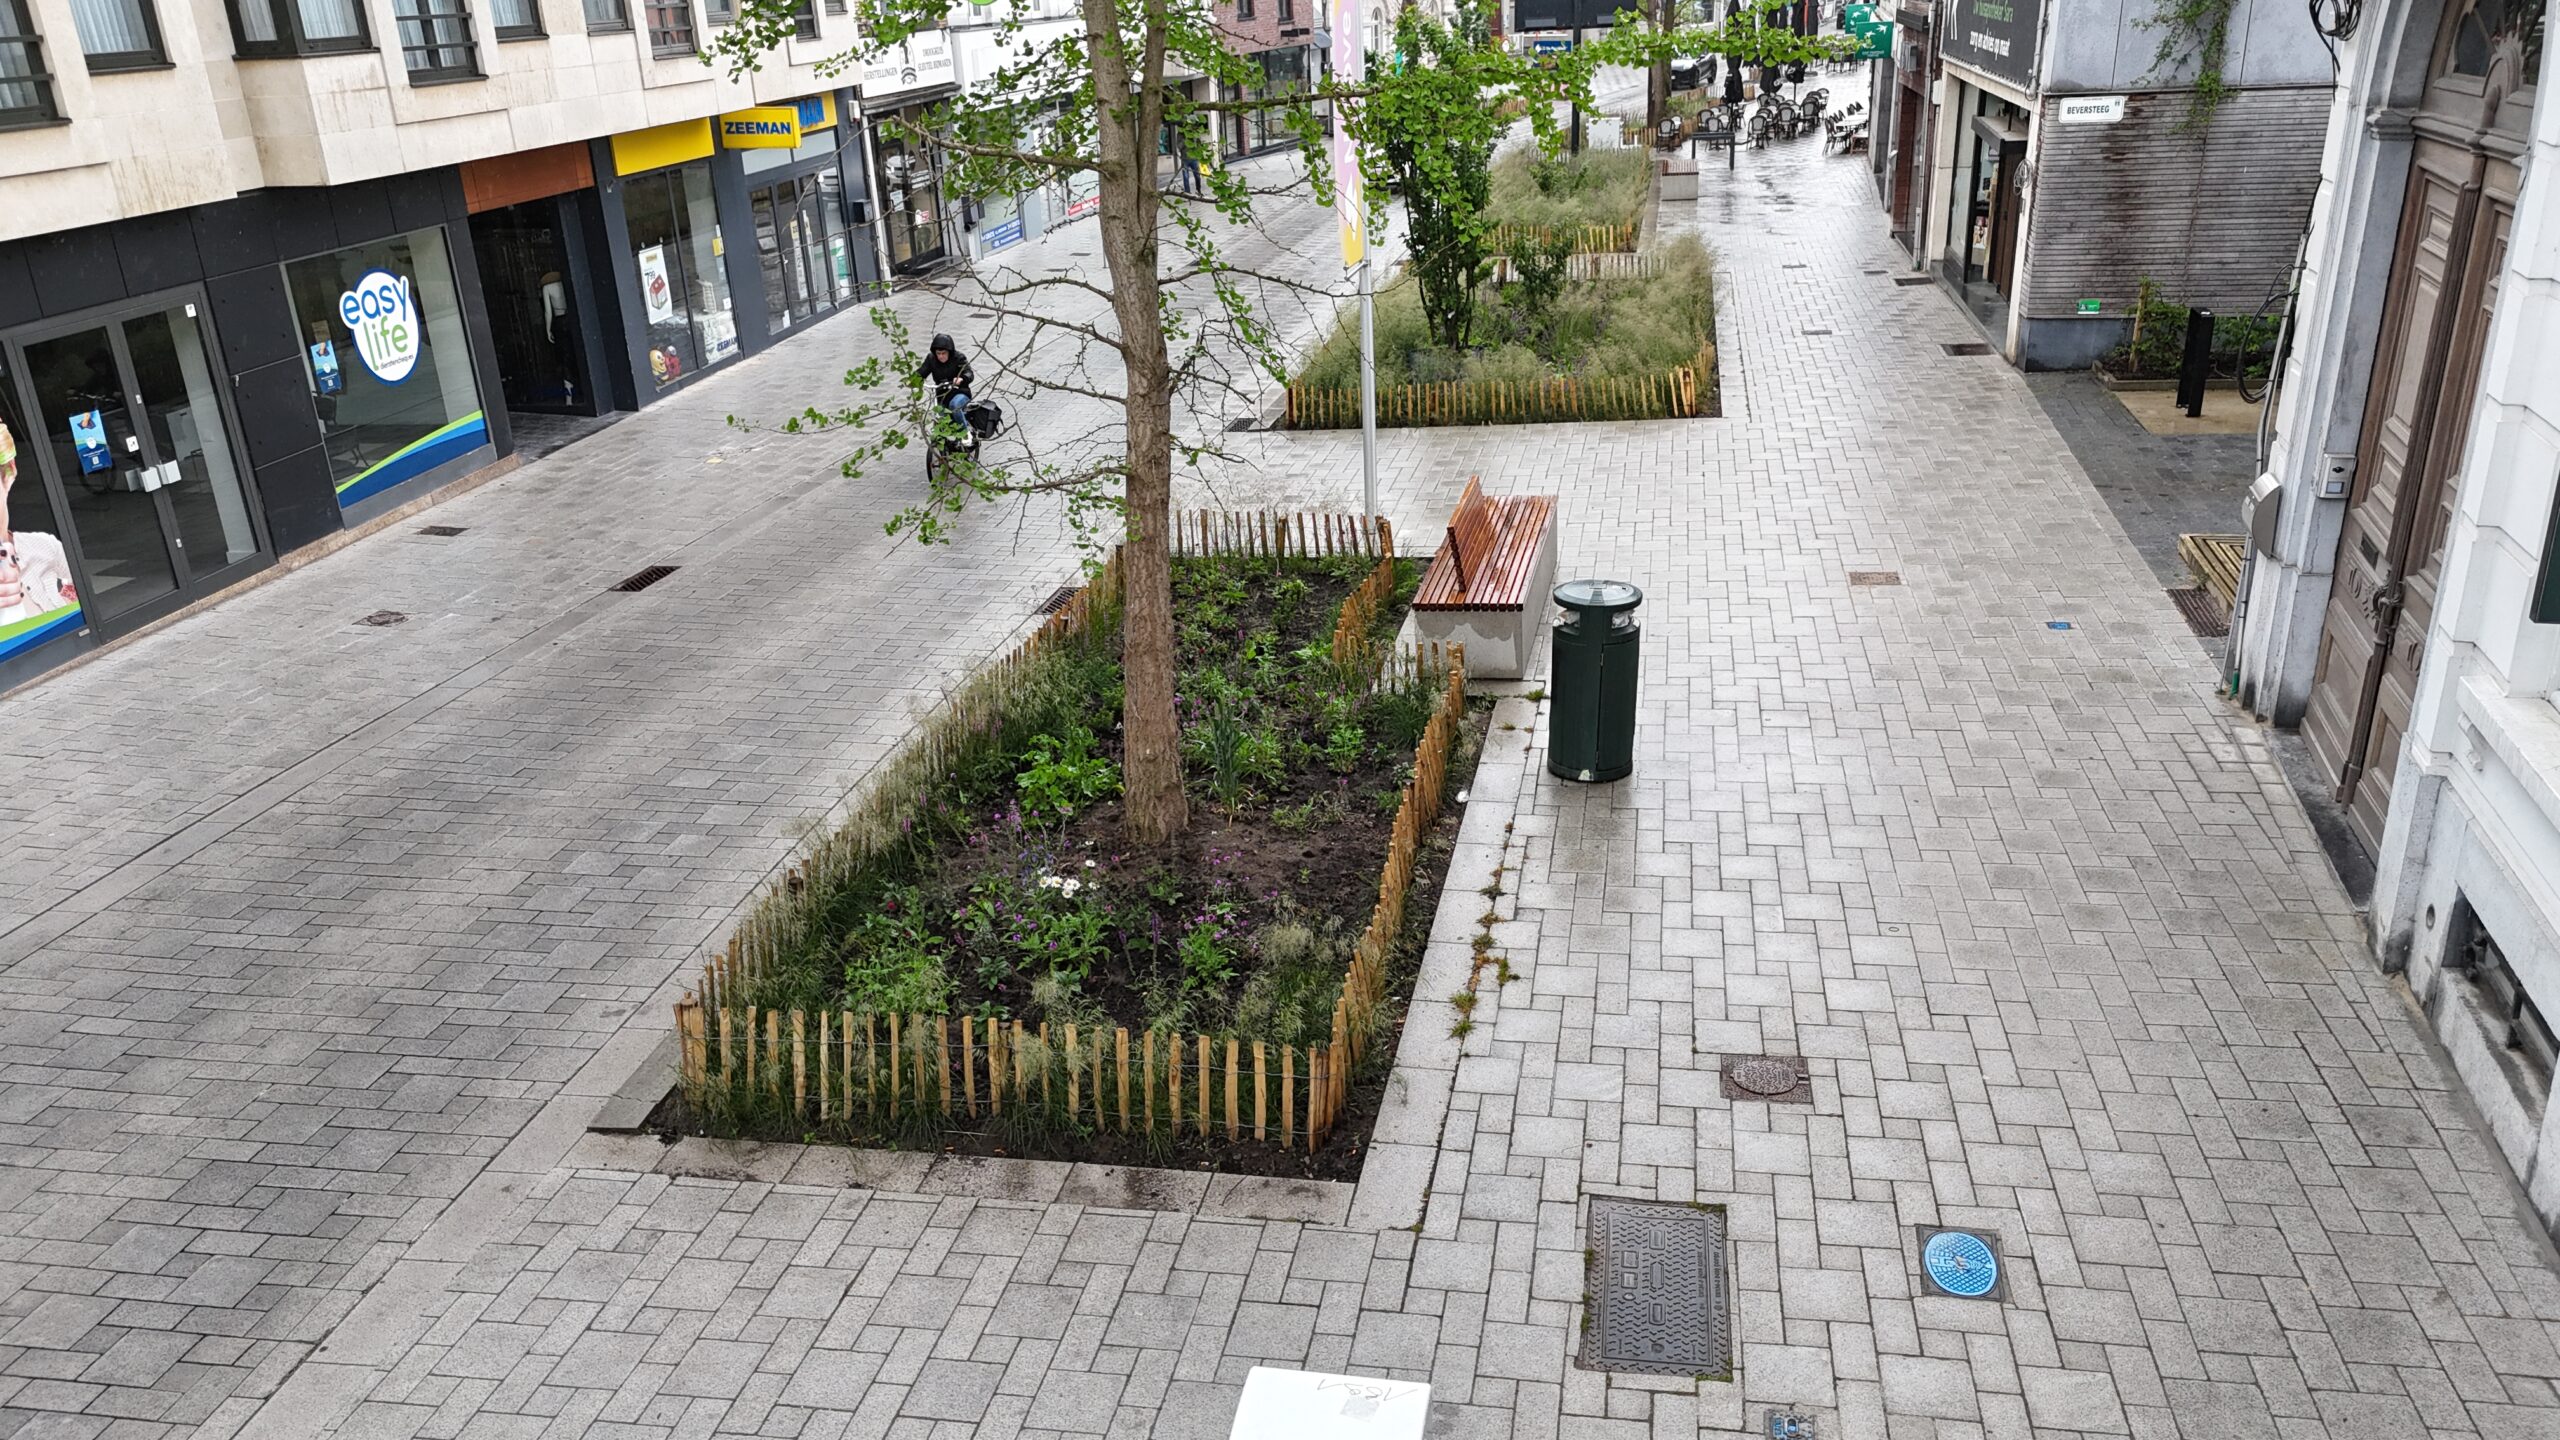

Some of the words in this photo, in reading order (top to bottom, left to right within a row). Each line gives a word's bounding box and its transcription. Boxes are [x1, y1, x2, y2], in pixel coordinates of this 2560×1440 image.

[2067, 105, 2110, 115] BEVERSTEEG
[724, 121, 791, 135] ZEEMAN
[342, 279, 407, 325] easy
[363, 315, 408, 371] life
